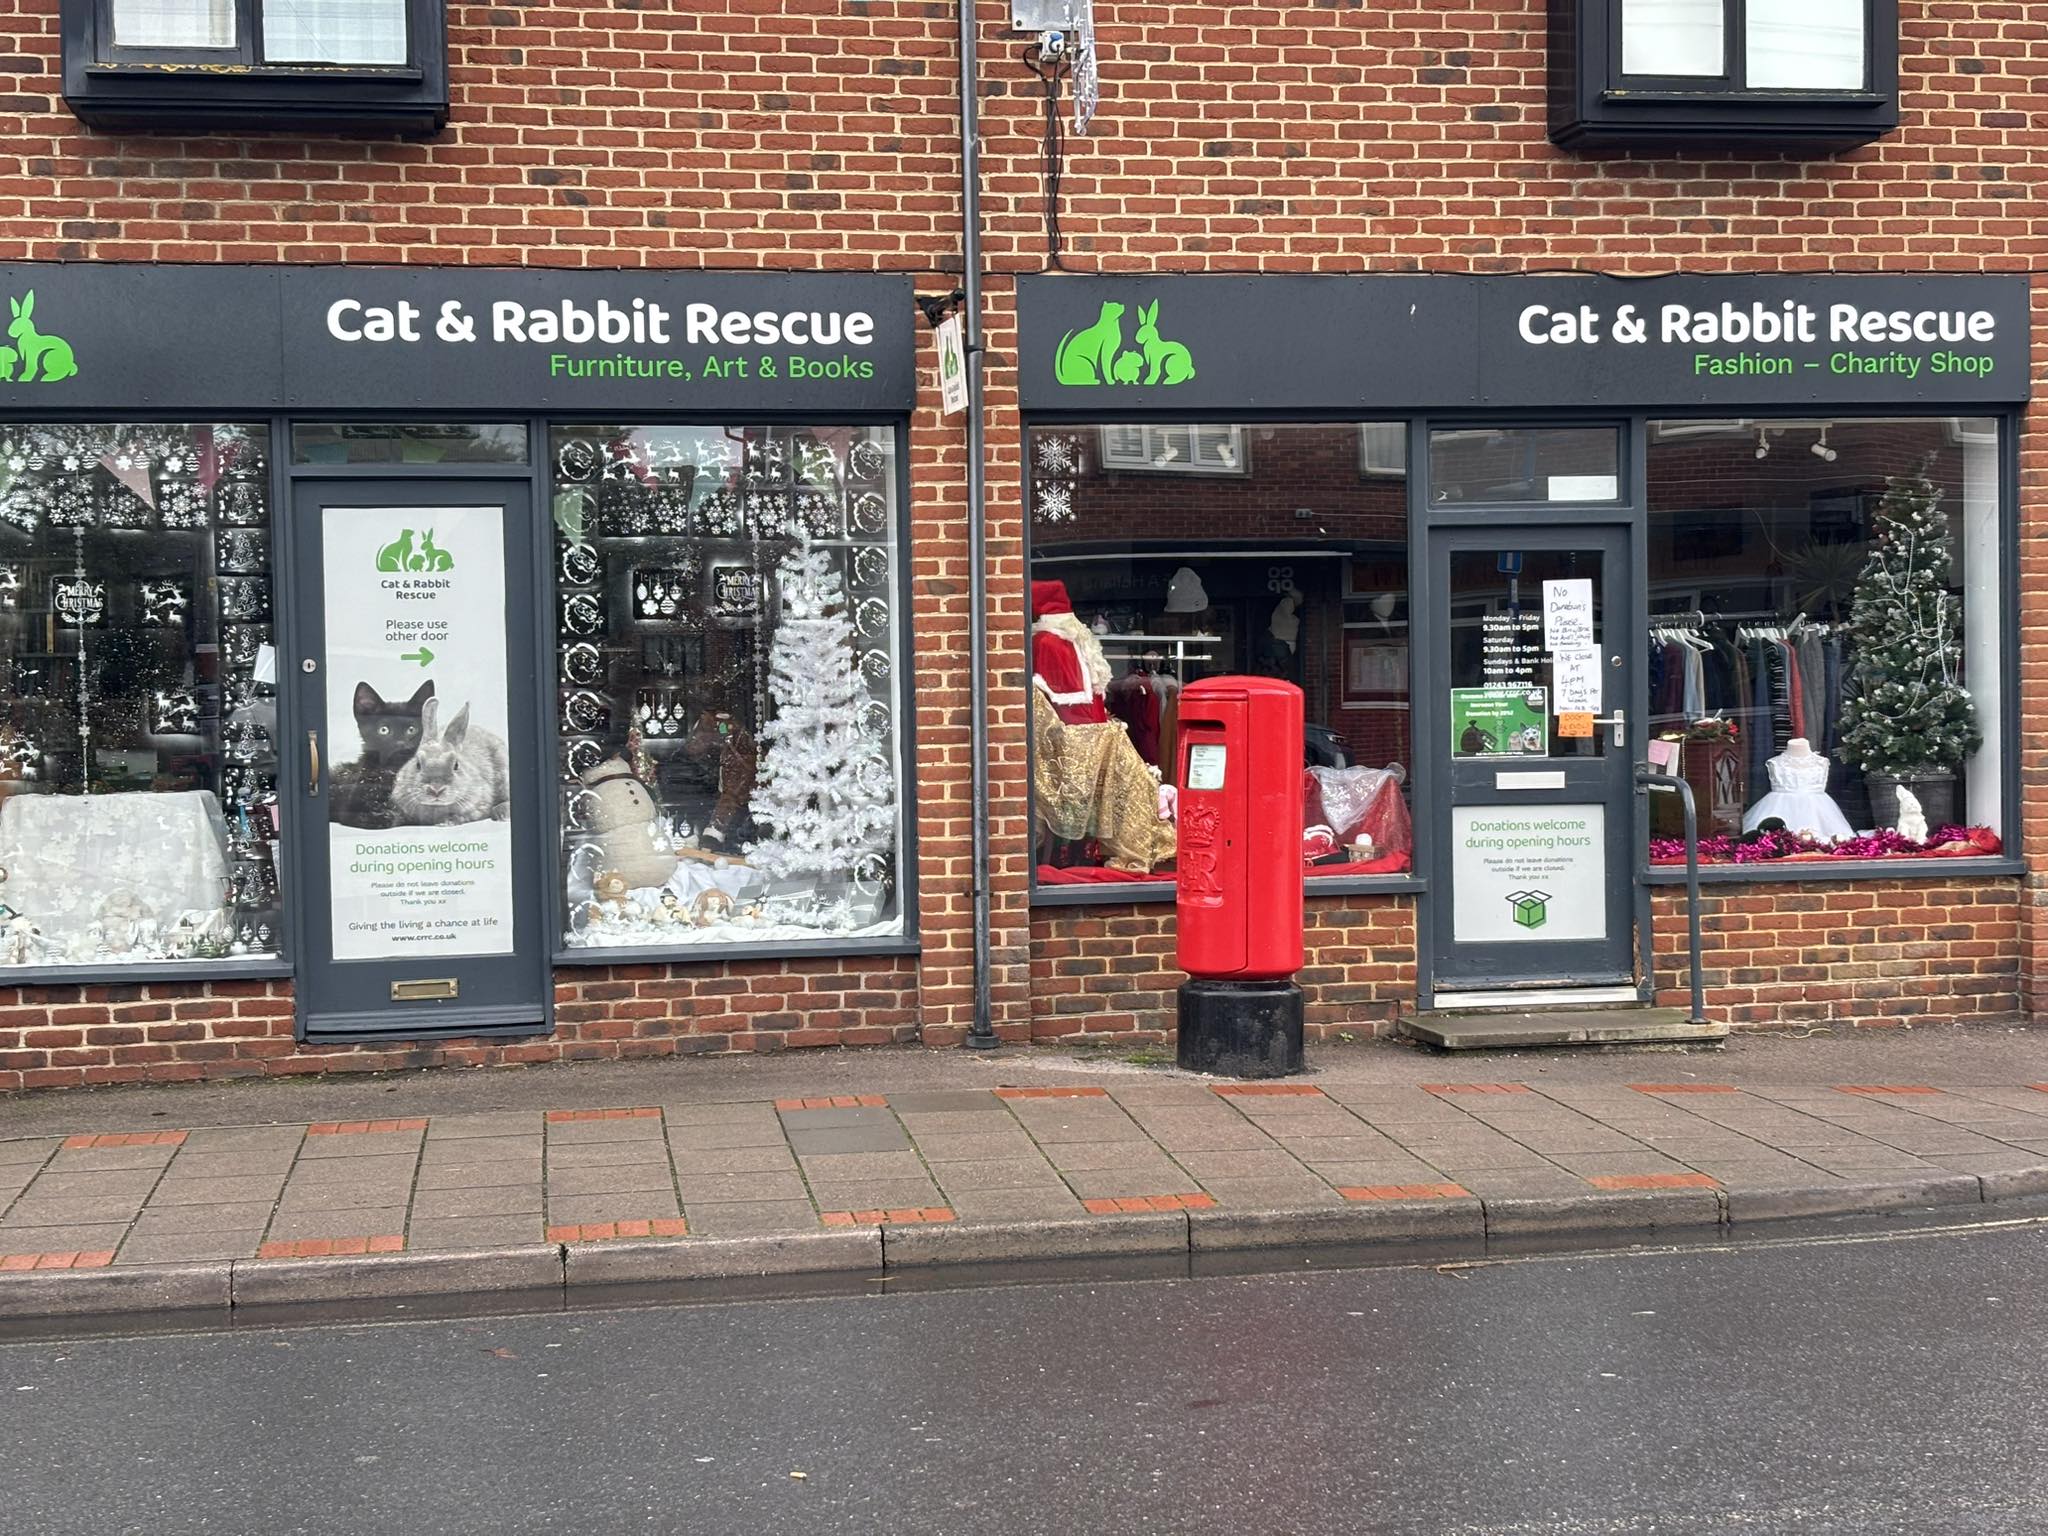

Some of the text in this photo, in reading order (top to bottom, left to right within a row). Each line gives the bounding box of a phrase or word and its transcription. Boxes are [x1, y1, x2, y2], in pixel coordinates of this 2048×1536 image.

[326, 297, 875, 344] Cat & Rabbit Rescue
[1519, 299, 1995, 344] Cat & Rabbit Rescue
[551, 353, 874, 382] Furniture, Art & Books
[1695, 353, 1793, 376] Fashion
[1830, 351, 1920, 379] Charity
[1930, 351, 1994, 377] Shop
[381, 579, 451, 588] Cat & Rabbit
[396, 591, 437, 599] Rescue
[1553, 587, 1568, 597] No
[55, 593, 103, 612] CHRISTMAS
[1519, 614, 1540, 622] Friday
[386, 620, 448, 629] Please use
[1522, 624, 1539, 632] 5pm
[385, 631, 449, 641] other door
[1522, 645, 1539, 653] 5pm
[1483, 658, 1512, 666] Sundays
[1483, 667, 1503, 675] 10am
[1515, 667, 1533, 675] 4pm
[1470, 819, 1586, 832] Donations welcome
[1465, 835, 1591, 849] during opening hours
[355, 841, 488, 855] Donations welcome
[350, 859, 495, 874] during opening hours
[349, 922, 377, 932] Giving
[380, 921, 396, 930] the
[398, 920, 424, 930] living
[434, 919, 468, 928] chance
[471, 919, 480, 927] at
[483, 918, 498, 926] life
[392, 933, 456, 941] www.crrc.co.uk
